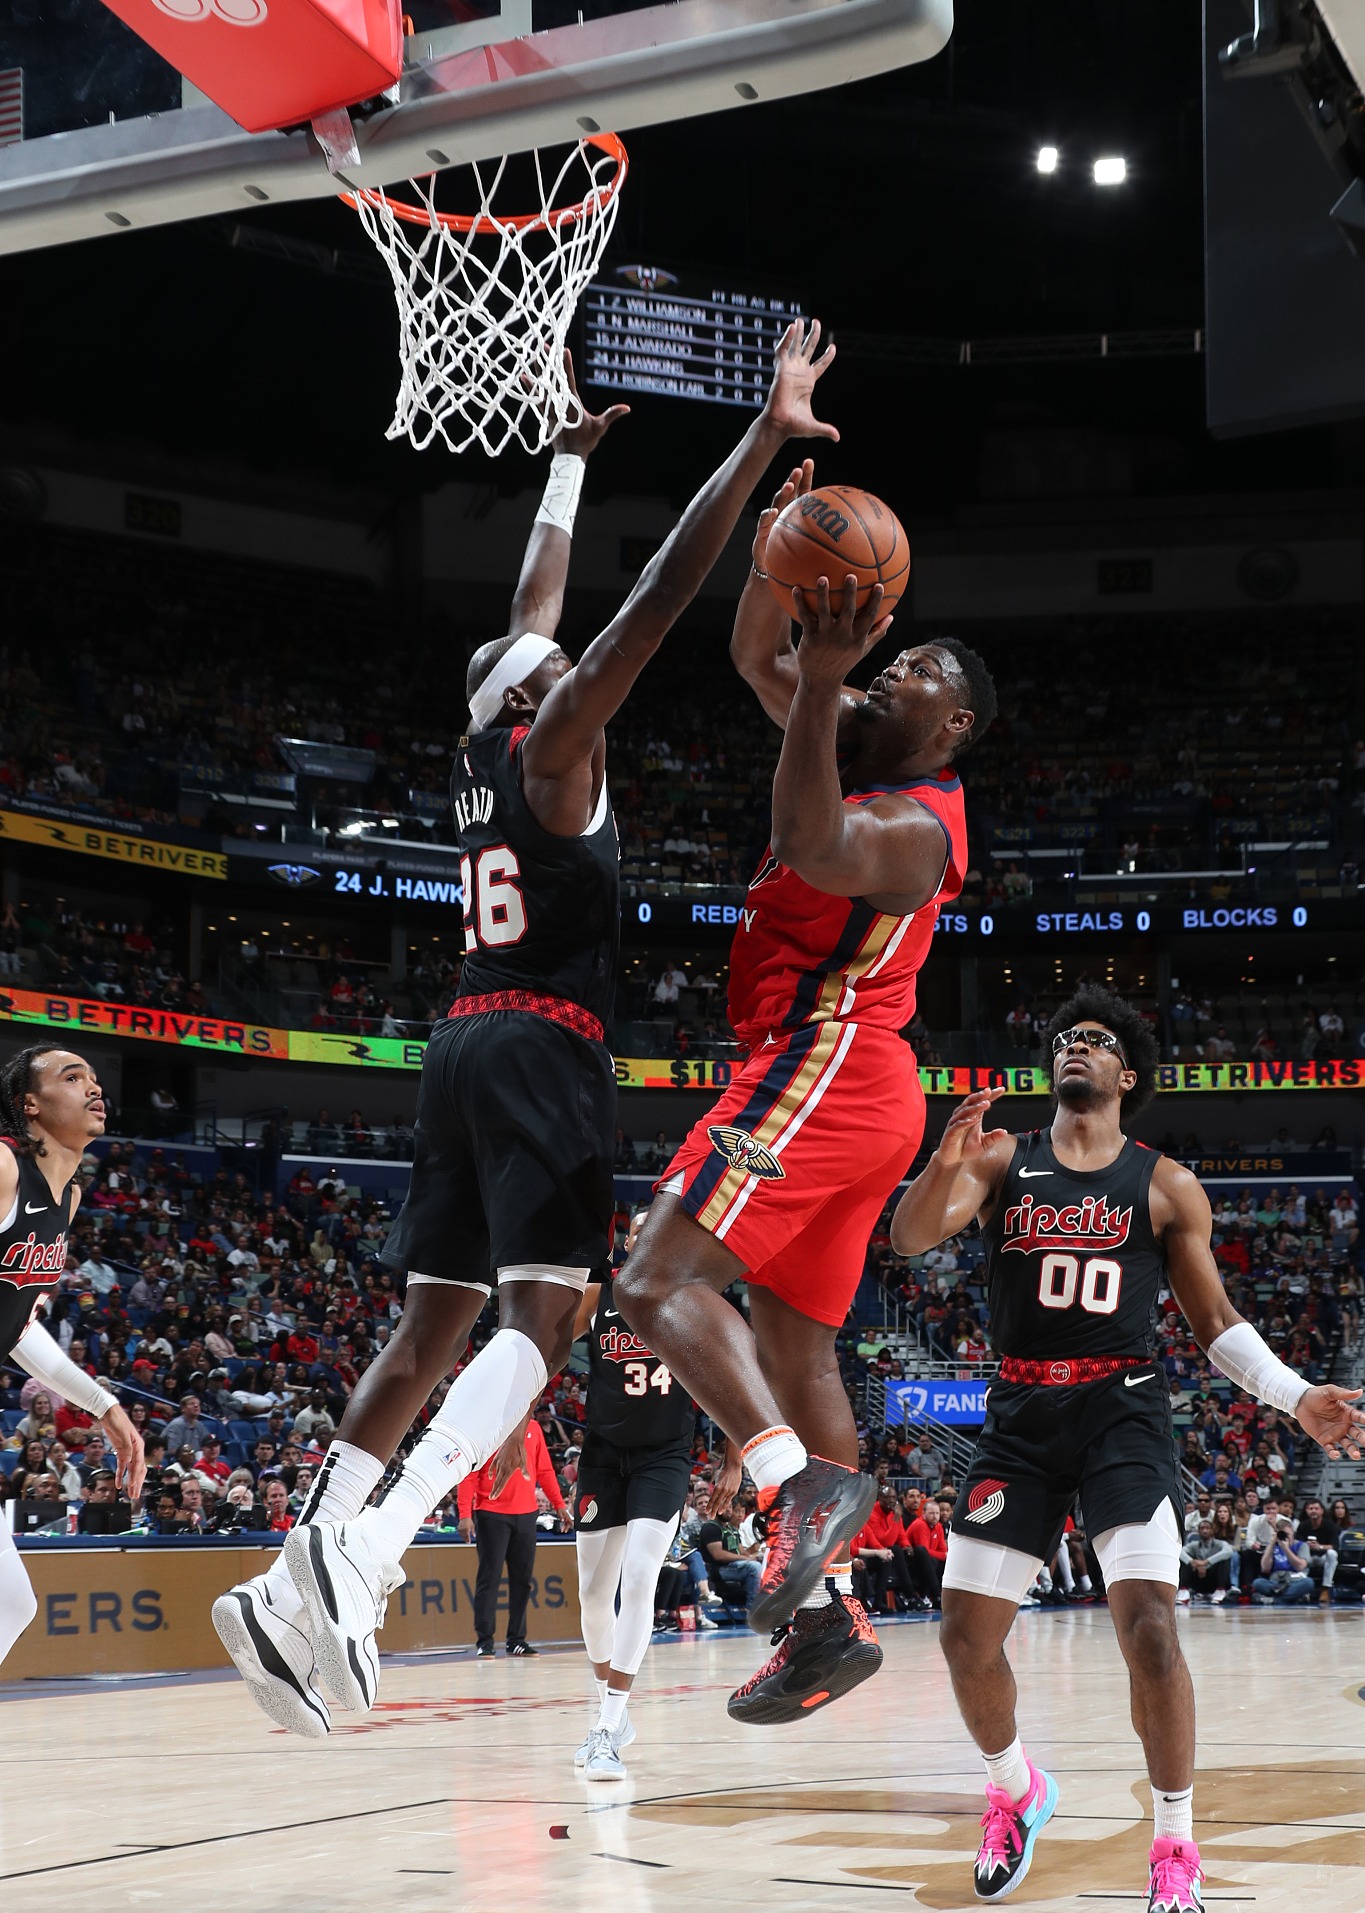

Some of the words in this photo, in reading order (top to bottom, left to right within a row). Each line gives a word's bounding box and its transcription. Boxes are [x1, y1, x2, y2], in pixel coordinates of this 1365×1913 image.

[626, 297, 706, 322] WILLIAMSON
[627, 316, 694, 338] MARSHALL
[624, 335, 692, 357] ALVARADO
[624, 354, 684, 375] HAWKINS
[71, 810, 112, 825] COMMUNITY
[113, 819, 143, 831] TICKETS
[334, 870, 362, 894] 24
[368, 874, 389, 897] J.
[395, 878, 463, 905] HAWK
[638, 903, 652, 923] 0
[1036, 911, 1123, 933] STEALS
[1136, 911, 1150, 931] 0
[1183, 907, 1278, 929] BLOCKS
[1293, 907, 1307, 927] 0
[980, 915, 994, 935] 0
[47, 998, 272, 1053] BETRIVERS
[1158, 1061, 1364, 1091] BETRIVERS
[1001, 1194, 1134, 1255] ripcity
[1038, 1252, 1124, 1316] 00
[624, 1362, 672, 1396] 34
